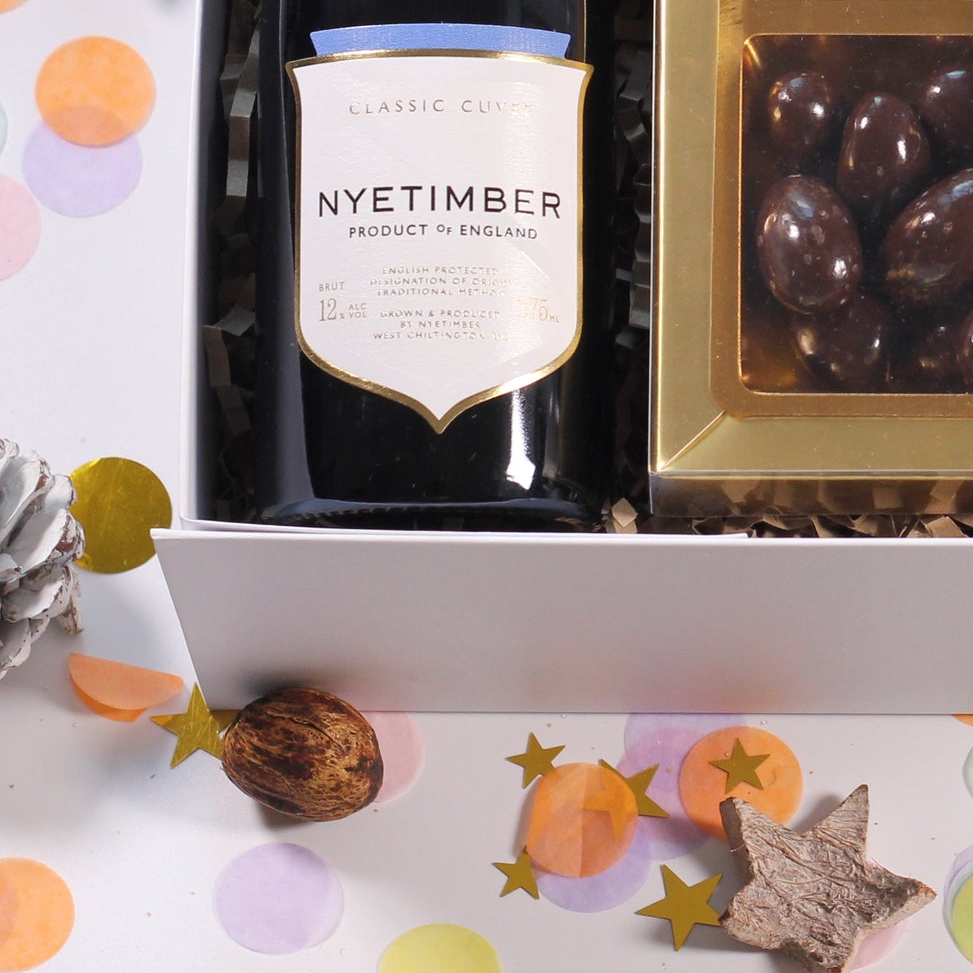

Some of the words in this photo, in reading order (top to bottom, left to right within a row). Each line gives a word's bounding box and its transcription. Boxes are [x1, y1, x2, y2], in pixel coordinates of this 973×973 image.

[349, 99, 445, 115] CLASSIC
[319, 185, 561, 218] NYETIMBER
[349, 224, 428, 238] PRODUCT
[437, 224, 453, 235] OF
[461, 225, 538, 240] ENGLAND
[383, 266, 429, 275] ENGLISH
[370, 277, 447, 286] DESIGNATION
[453, 278, 467, 286] OF
[319, 282, 345, 292] BRUT
[377, 288, 453, 297] TRADITIONAL
[348, 303, 367, 311] ALC
[348, 311, 368, 319] VOL
[381, 310, 424, 318] GROWN
[400, 321, 412, 329] BY
[419, 321, 481, 329] NYETIMBER
[373, 332, 401, 340] WEST
